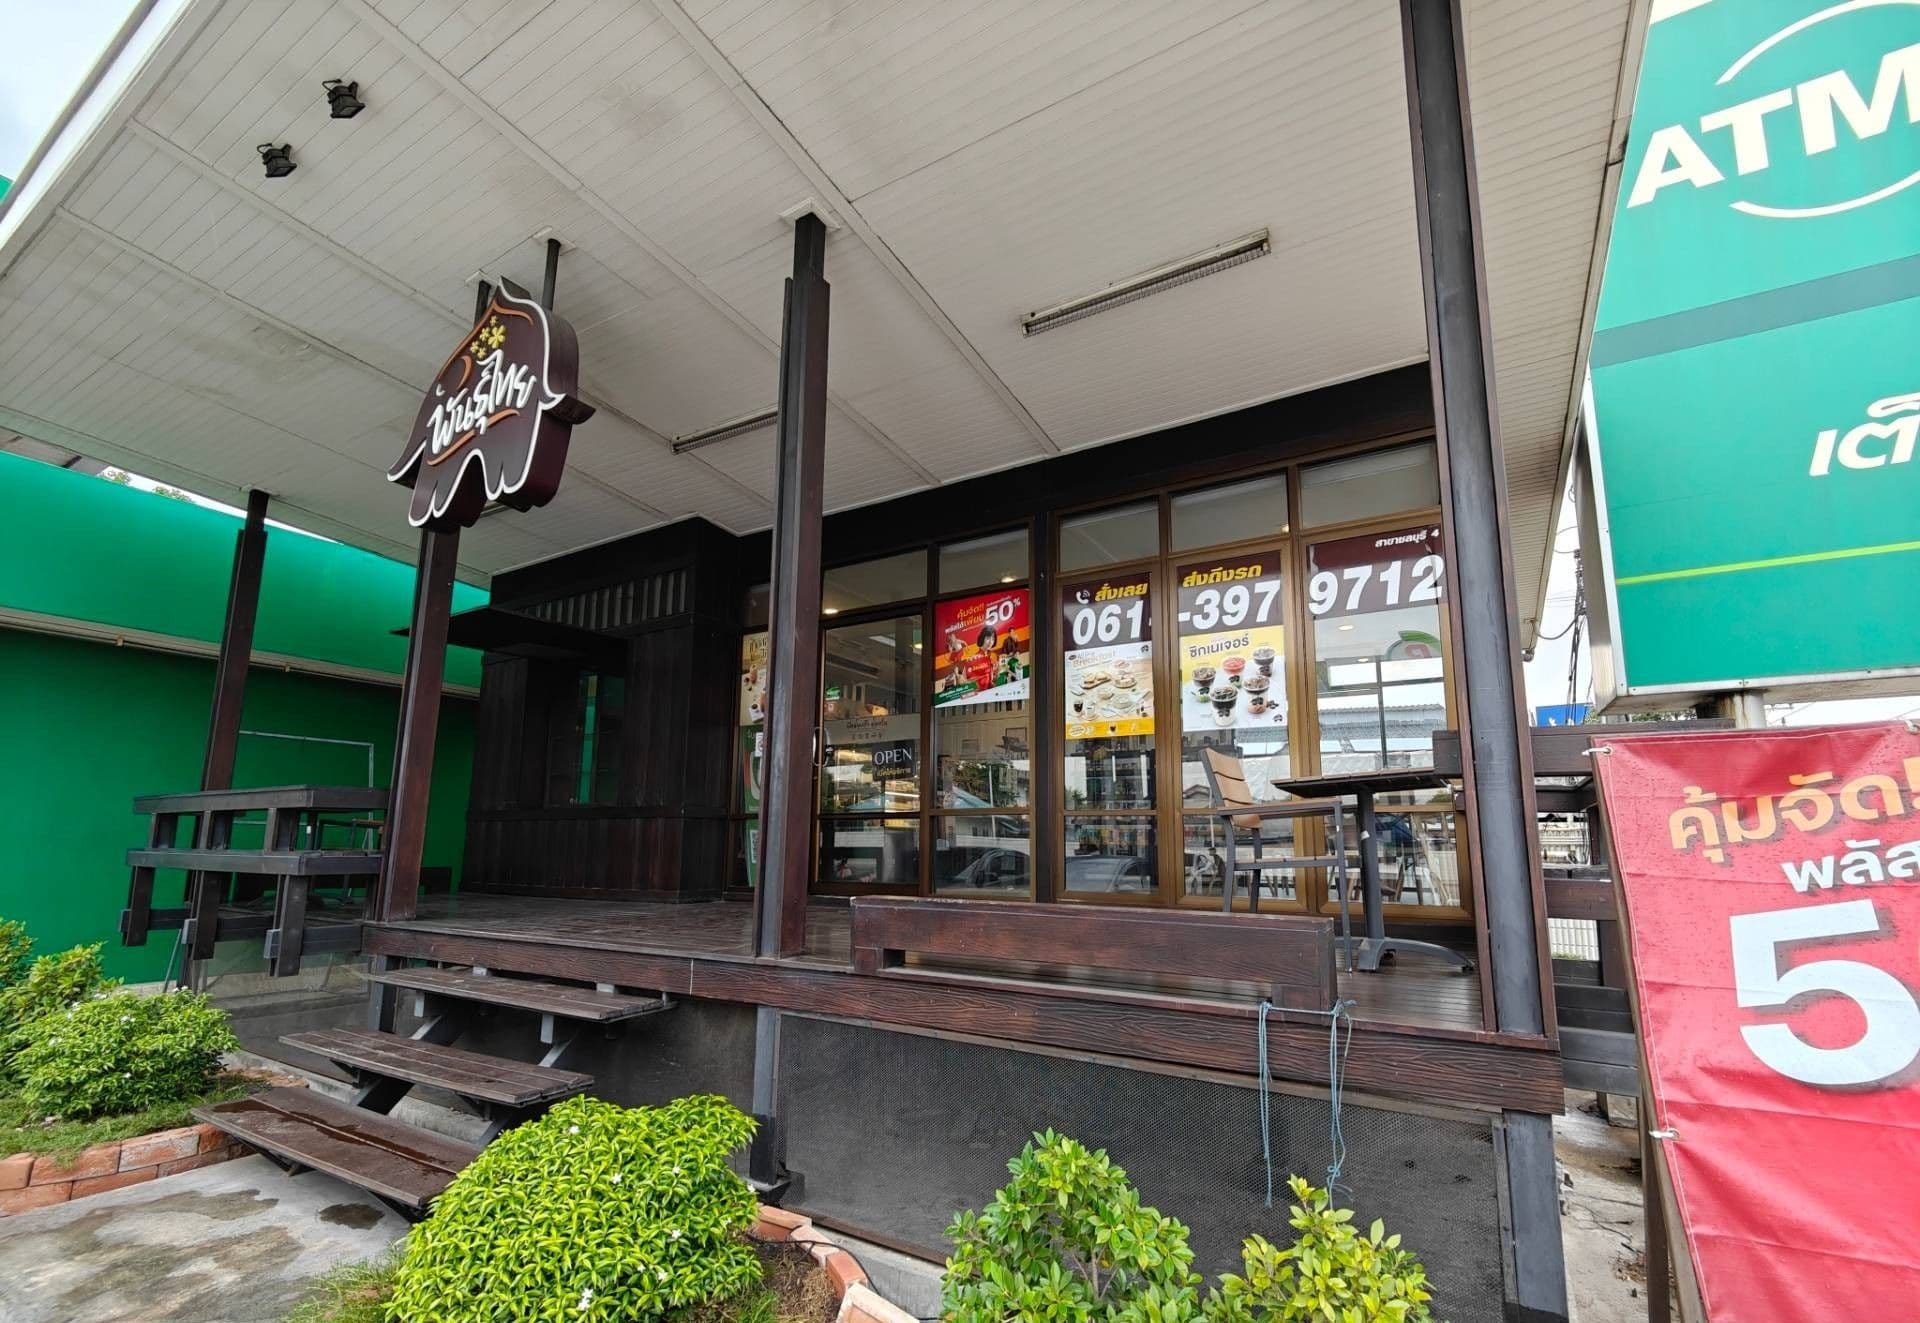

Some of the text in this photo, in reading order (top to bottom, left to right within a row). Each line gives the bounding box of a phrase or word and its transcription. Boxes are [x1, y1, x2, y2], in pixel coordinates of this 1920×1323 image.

[1626, 42, 1920, 209] ATM
[1375, 528, 1440, 548] สาขาชลบุรี 4
[1094, 583, 1149, 602] สั่งเลย
[1308, 554, 1446, 616] 9712
[874, 746, 913, 765] OPEN
